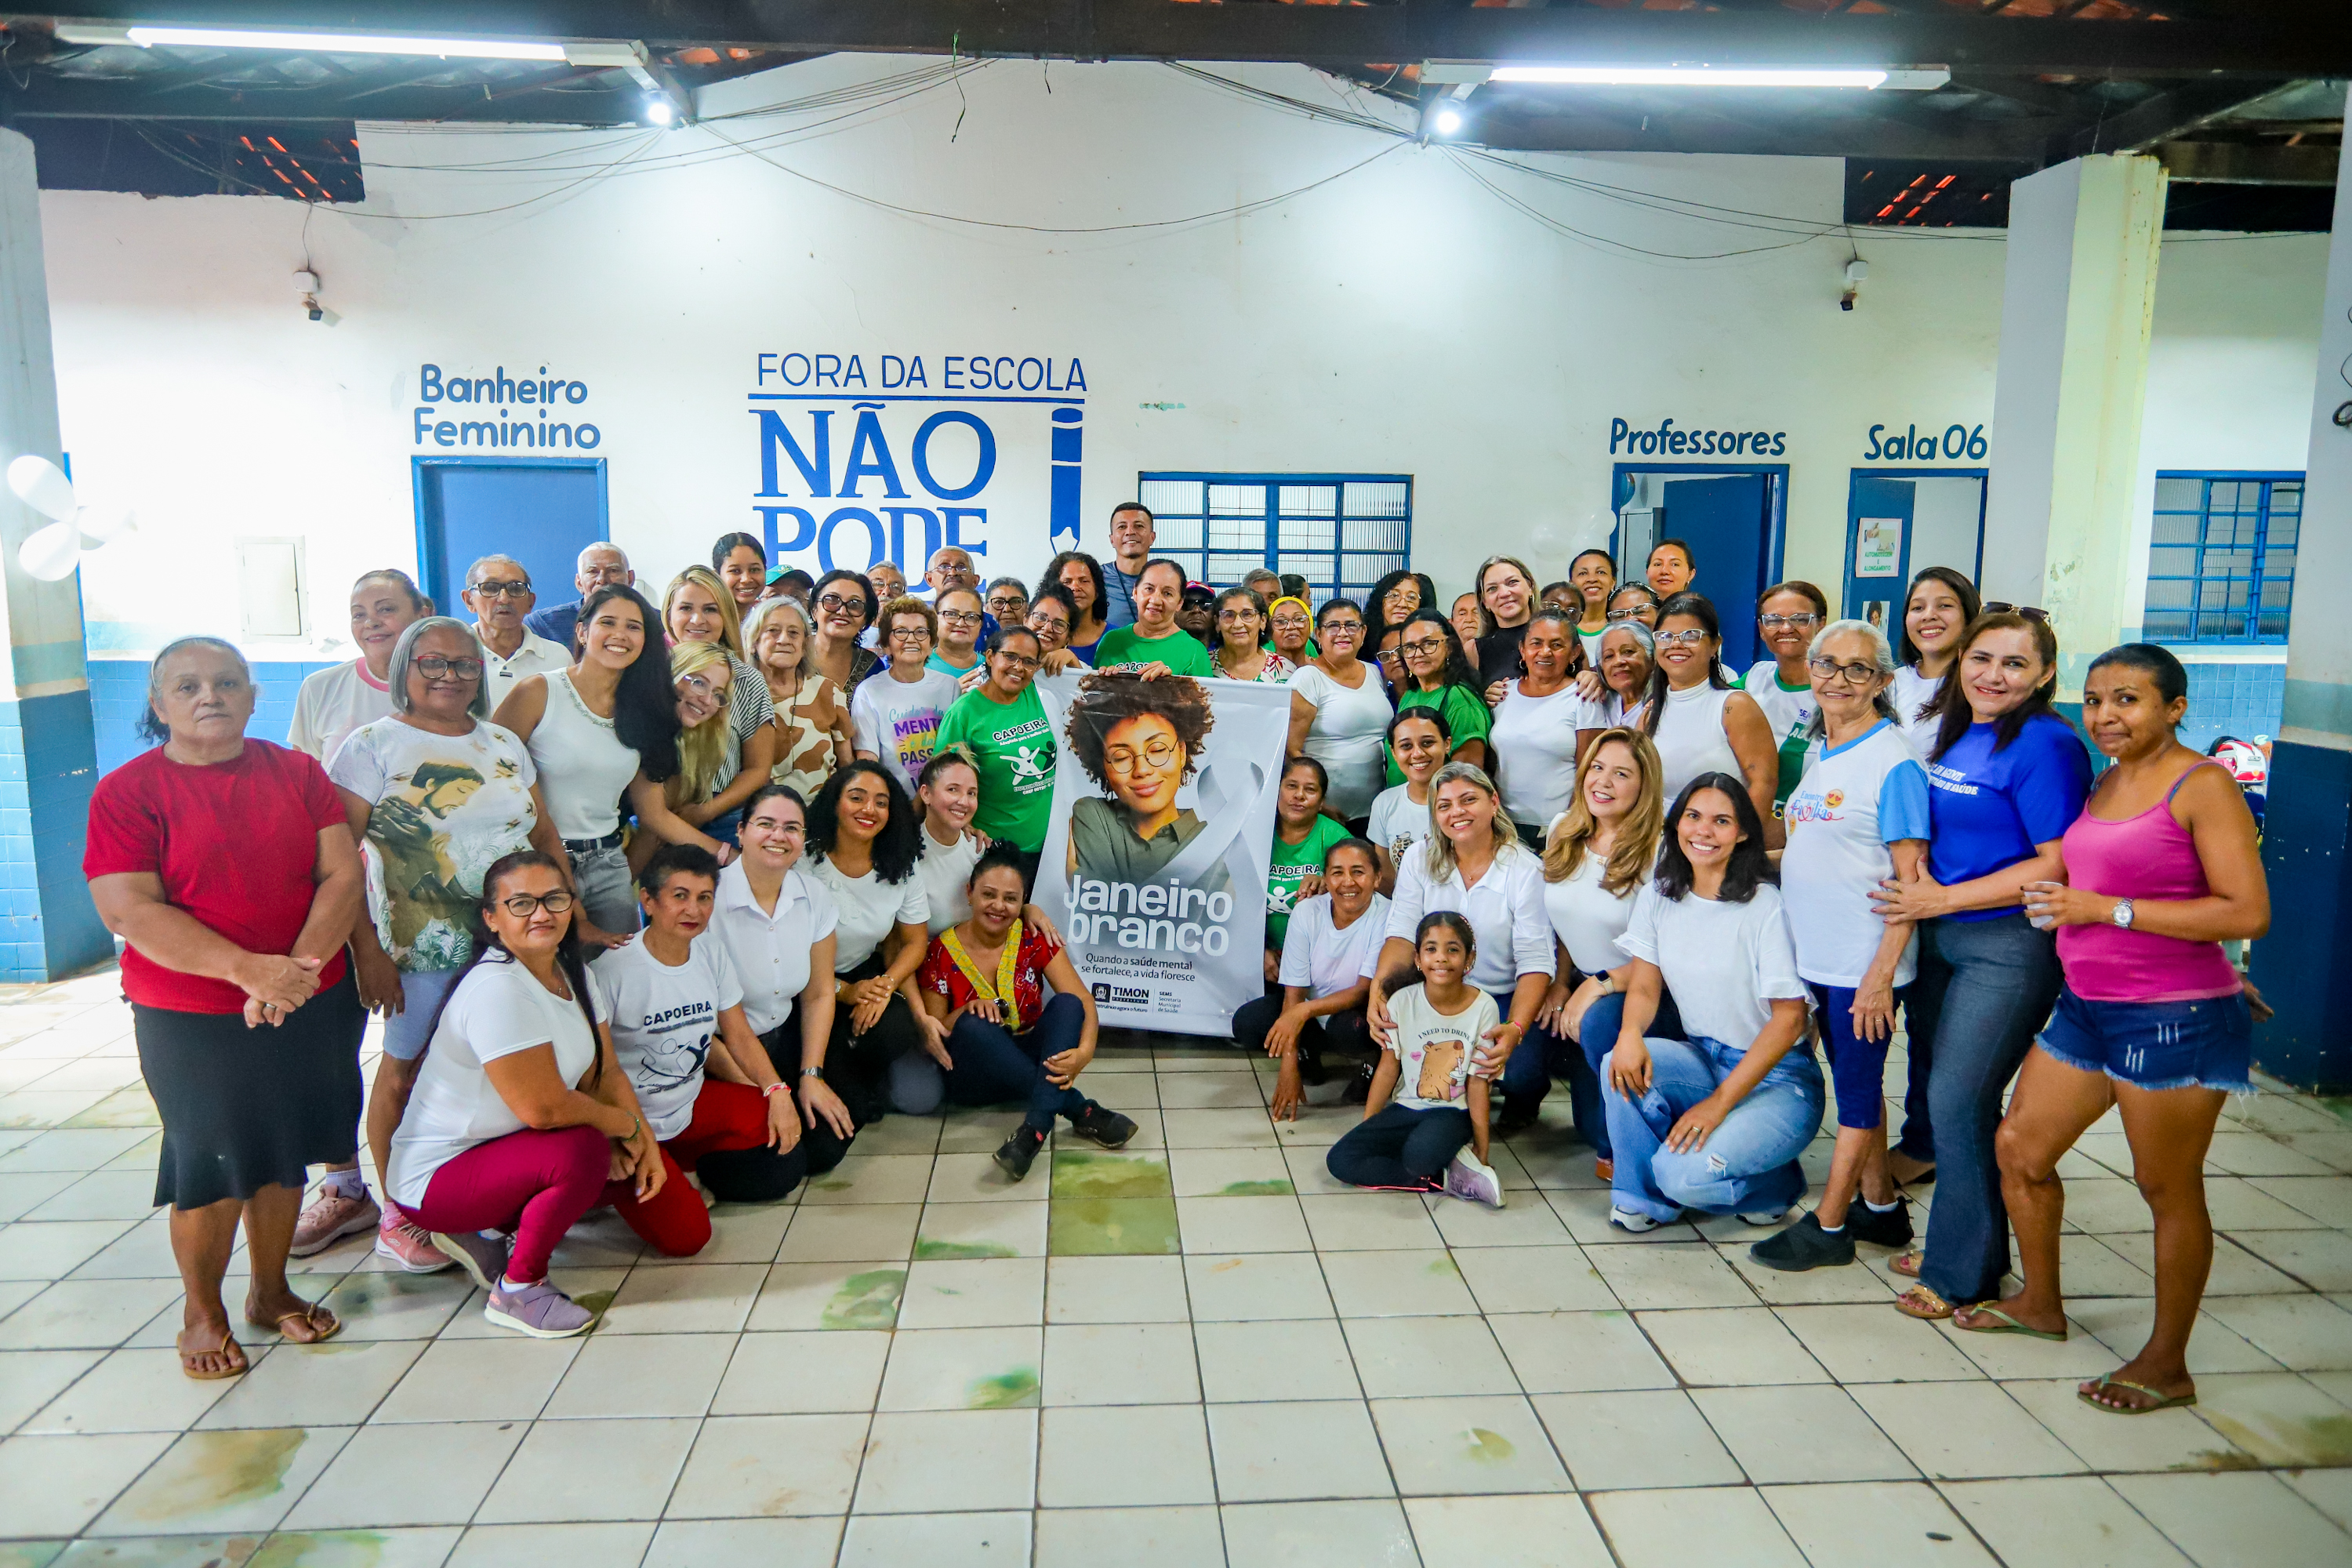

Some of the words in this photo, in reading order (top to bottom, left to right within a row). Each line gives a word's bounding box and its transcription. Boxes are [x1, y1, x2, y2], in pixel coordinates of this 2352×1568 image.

[421, 364, 587, 404] Banheiro
[758, 353, 868, 388] FORA
[881, 355, 928, 388] DA
[945, 356, 1087, 391] ESCOLA
[414, 407, 601, 448] Feminino
[1610, 418, 1786, 456] Professores
[748, 402, 996, 500] NÃO
[1864, 424, 1937, 459] Sala
[1942, 424, 1987, 459] 06
[894, 717, 942, 737] MENT
[993, 717, 1048, 742] CAPOEIRA
[900, 748, 933, 766] PASS
[1269, 864, 1321, 877] APOEIRA
[1067, 909, 1229, 956] branco
[1086, 953, 1122, 964] Quando
[1130, 956, 1158, 967] saúde
[1159, 960, 1192, 971] mental
[1092, 964, 1132, 978] fortalece,
[1141, 969, 1160, 978] vida
[1160, 971, 1196, 982] floresce
[1112, 986, 1149, 998] TIMON
[644, 1000, 713, 1026] CAPOEIRA
[1421, 1028, 1439, 1037] NEED
[1451, 1029, 1471, 1041] DRINK
